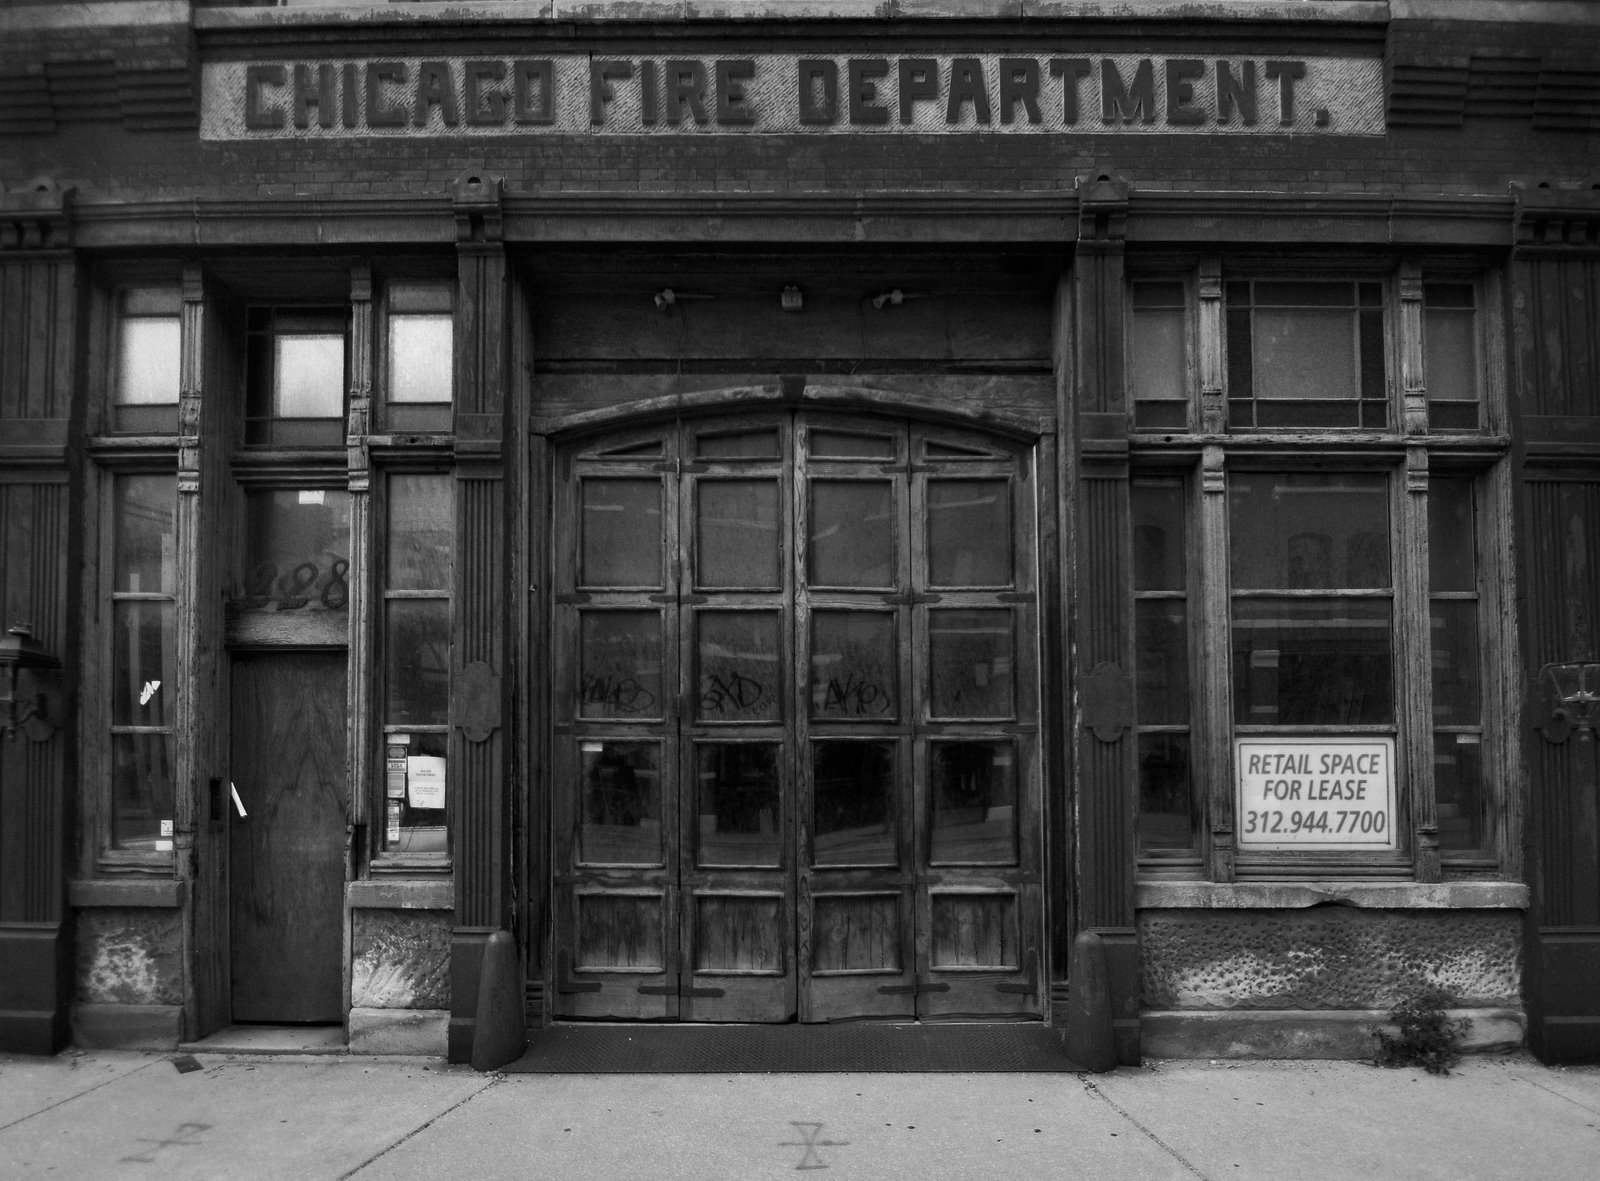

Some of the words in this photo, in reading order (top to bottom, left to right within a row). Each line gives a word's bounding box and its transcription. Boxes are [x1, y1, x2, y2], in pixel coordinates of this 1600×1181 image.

[245, 59, 556, 130] CHICAGO
[590, 58, 757, 128] FIRE
[1248, 753, 1313, 775] RETAIL
[1319, 753, 1381, 775] SPACE
[1263, 779, 1302, 801] FOR
[1307, 779, 1368, 801] LEASE
[1244, 810, 1386, 834] 312.944.7700
